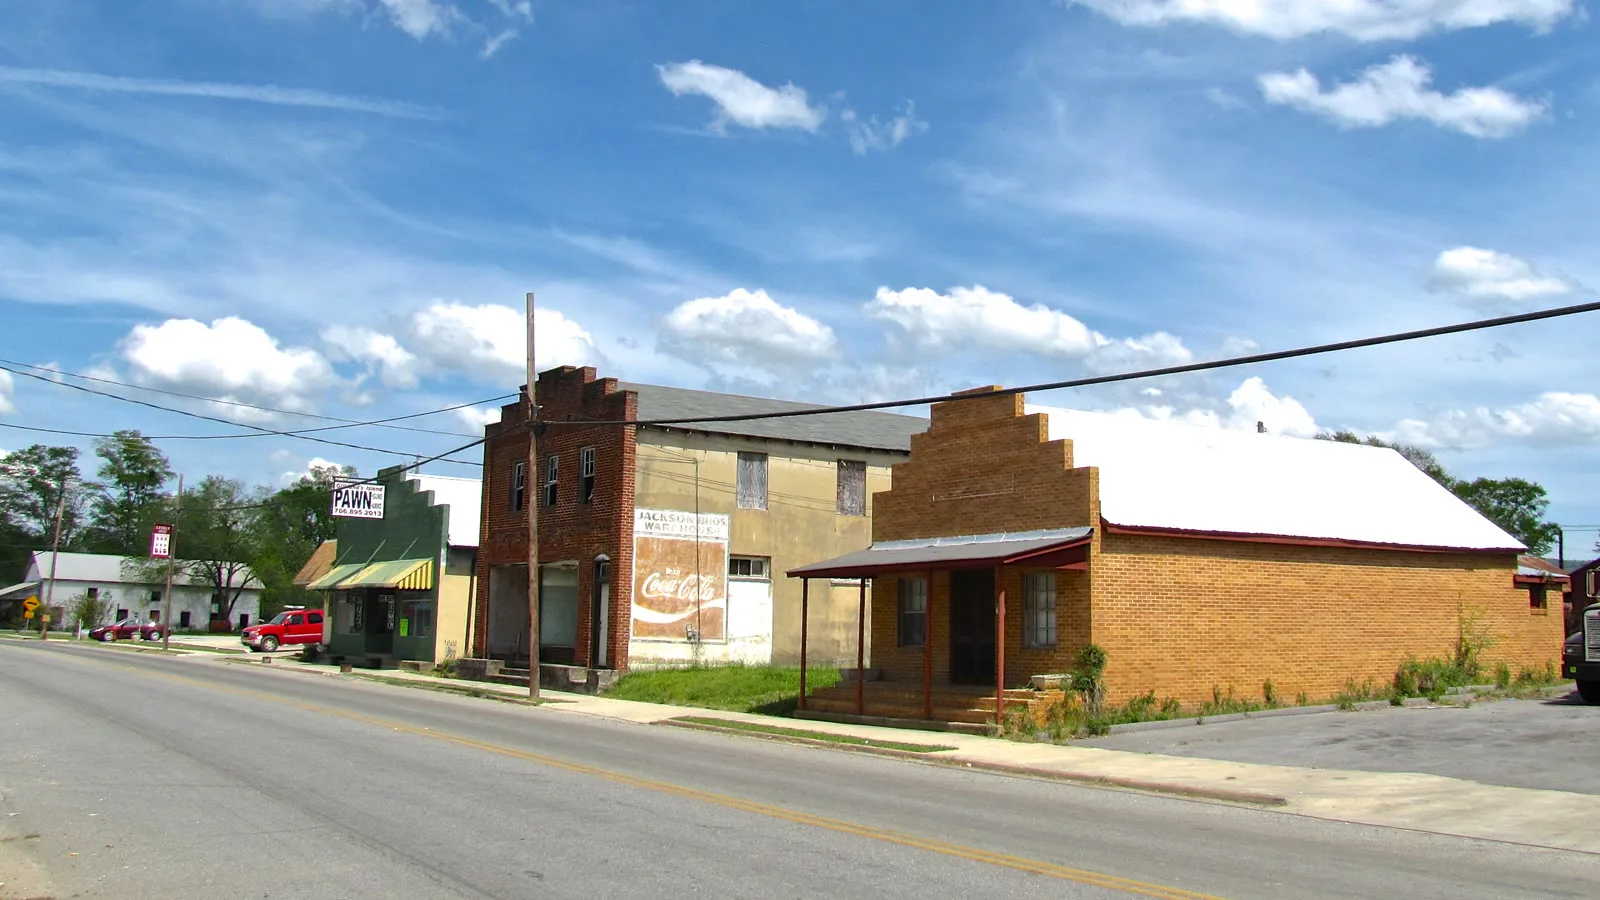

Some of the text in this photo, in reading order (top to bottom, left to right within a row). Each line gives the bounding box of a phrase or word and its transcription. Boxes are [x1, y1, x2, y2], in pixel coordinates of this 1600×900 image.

[335, 489, 372, 509] PAWN
[638, 511, 695, 523] JACKSON
[644, 522, 721, 534] WAREHOUSE
